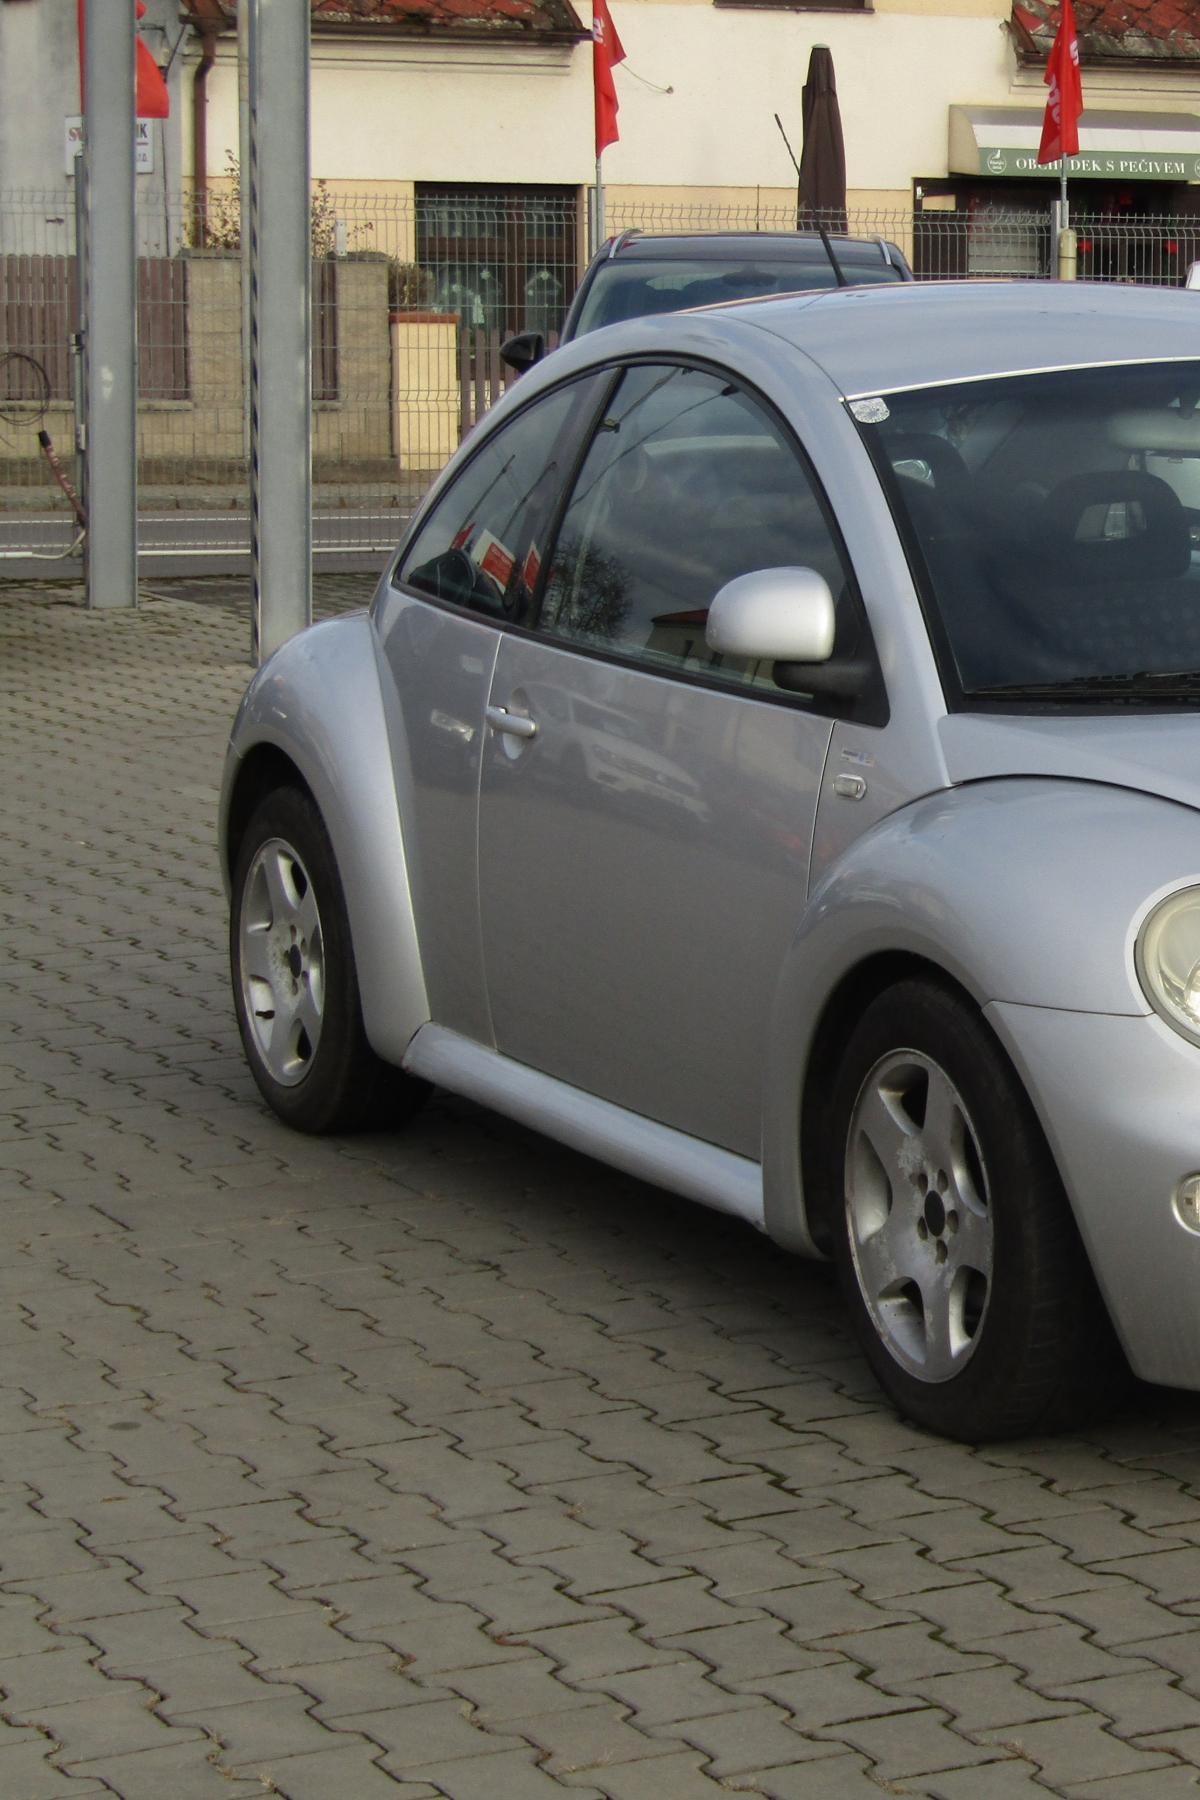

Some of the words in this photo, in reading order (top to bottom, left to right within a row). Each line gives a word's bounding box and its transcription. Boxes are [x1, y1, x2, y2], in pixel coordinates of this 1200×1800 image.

[1015, 158, 1102, 171] OBCHDEK
[1105, 160, 1115, 172] S
[1119, 159, 1185, 174] PEČIVEM
